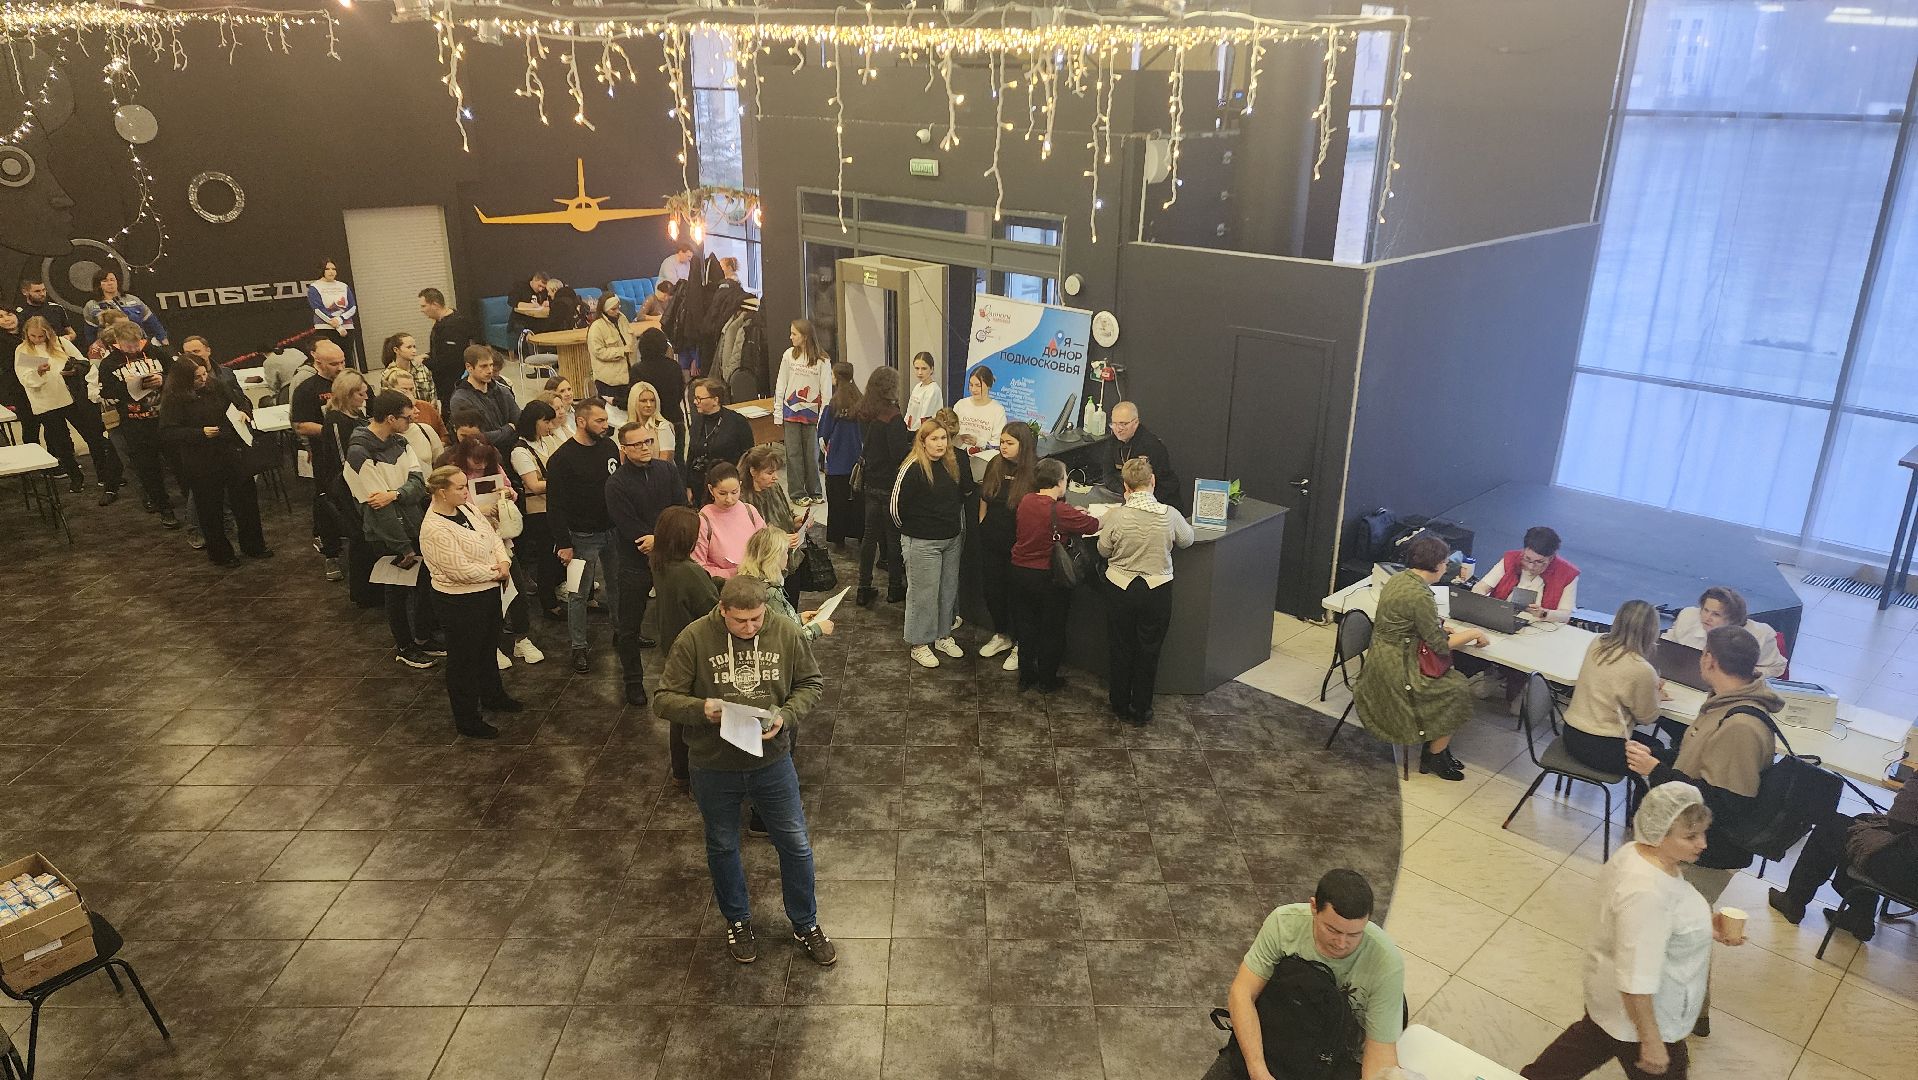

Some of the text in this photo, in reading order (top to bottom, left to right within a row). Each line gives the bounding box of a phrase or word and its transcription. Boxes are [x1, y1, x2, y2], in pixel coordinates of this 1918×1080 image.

[1064, 337, 1072, 348] Я
[1042, 346, 1083, 361] ДОНОР
[1000, 351, 1081, 375] ПОДМОСКОВЬЯ
[713, 671, 730, 684] 19
